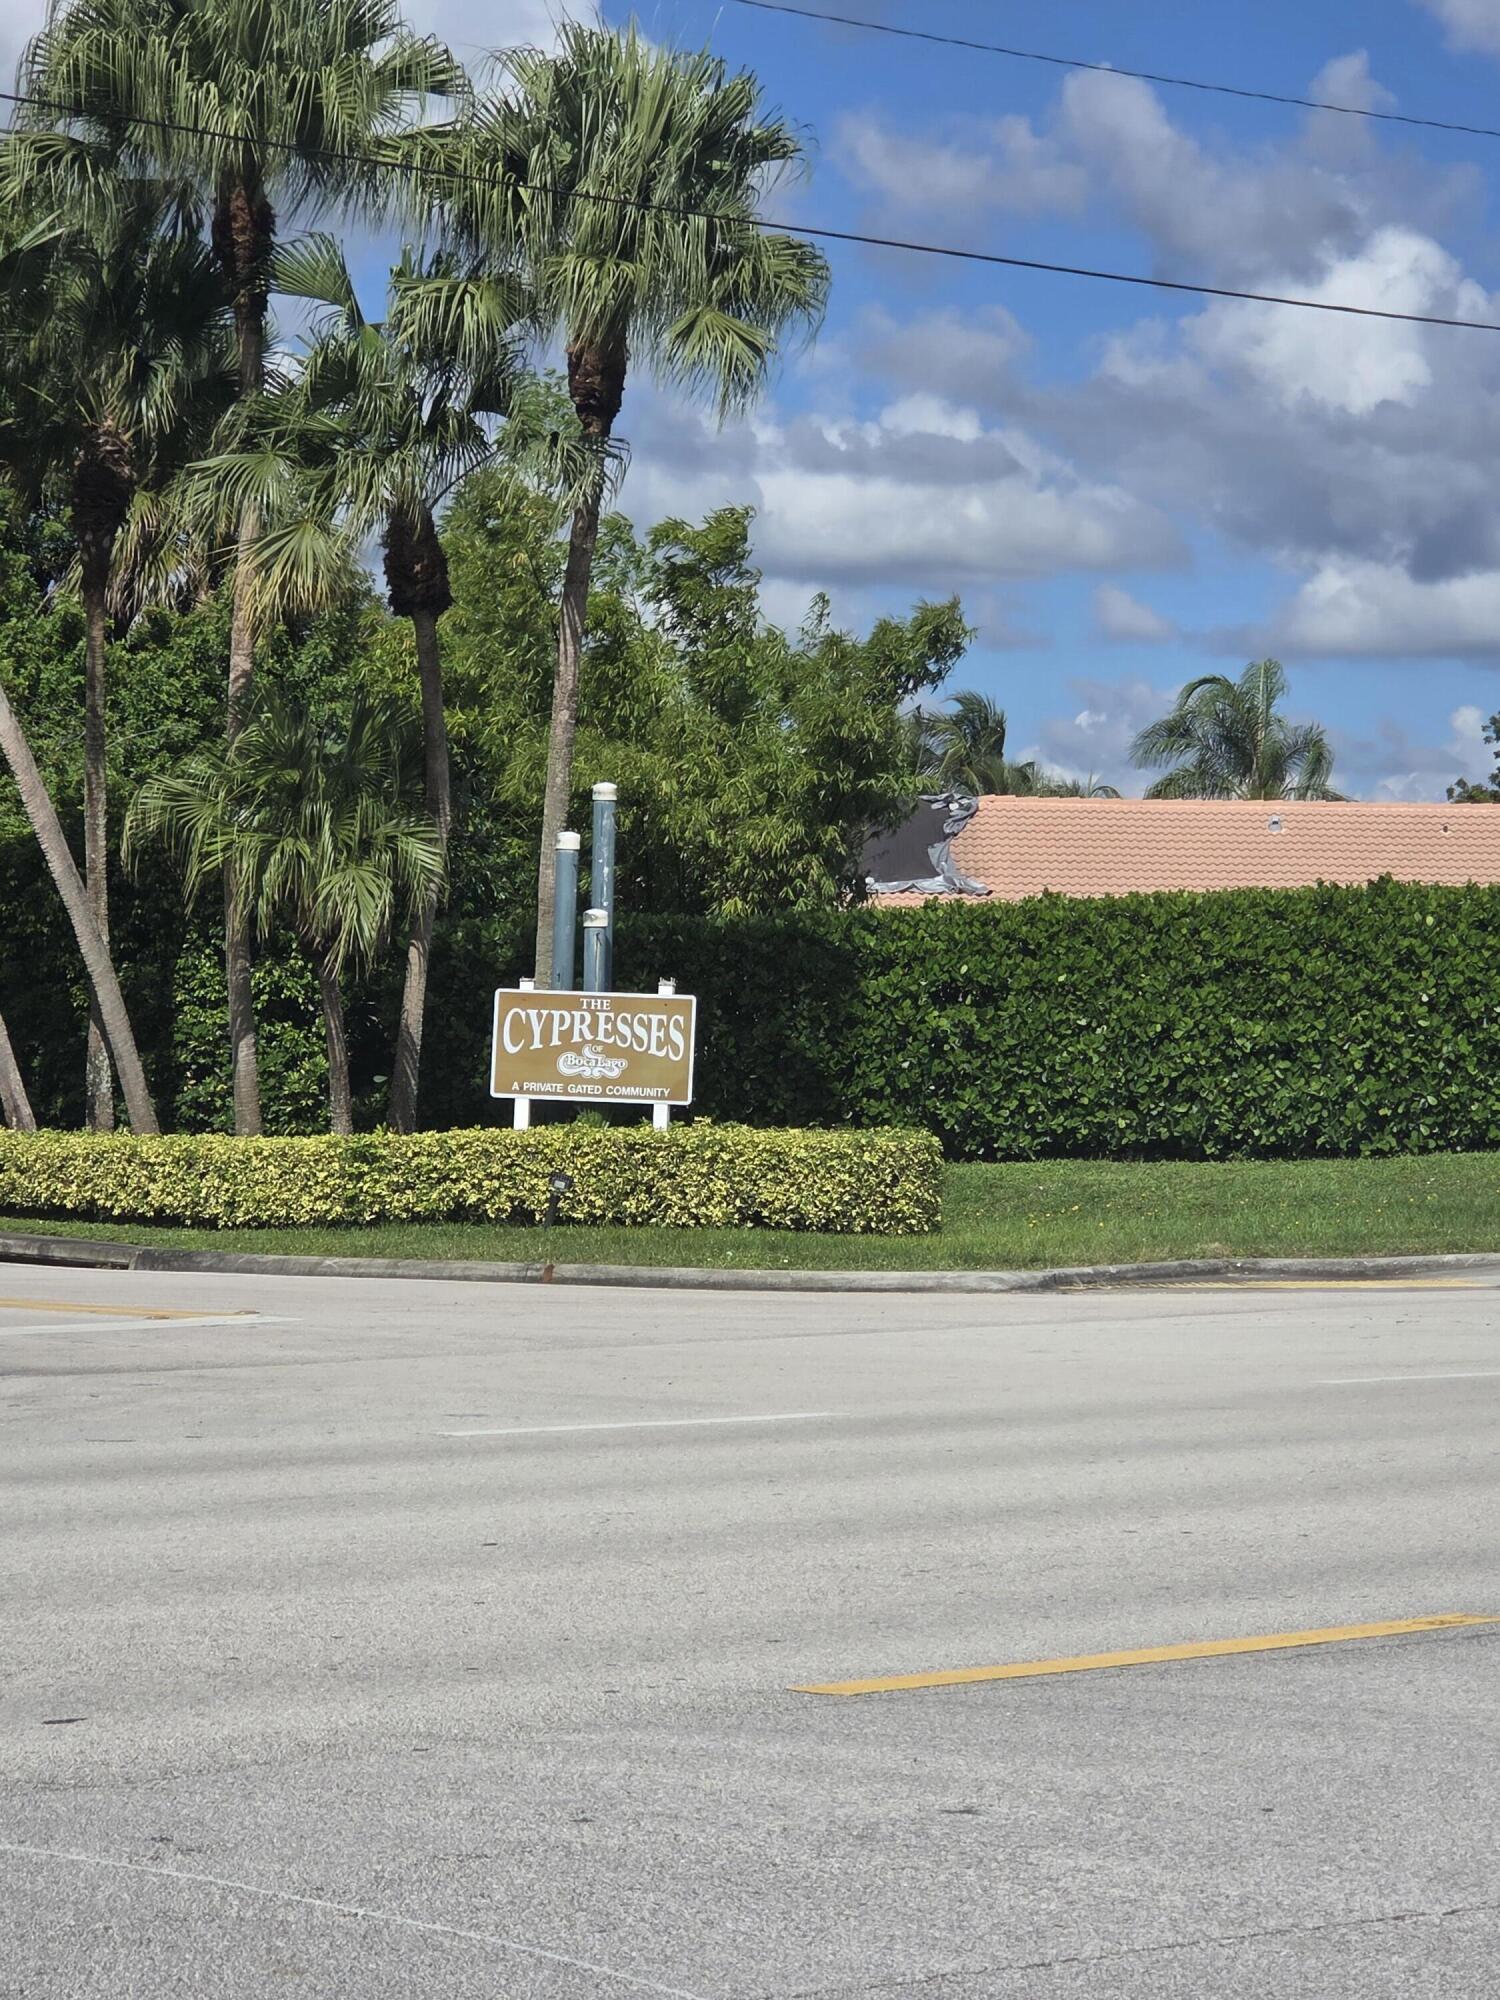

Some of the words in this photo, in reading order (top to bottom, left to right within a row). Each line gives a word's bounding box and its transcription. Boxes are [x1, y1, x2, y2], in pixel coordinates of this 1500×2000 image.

[580, 998, 611, 1010] THE
[503, 1007, 685, 1061] CYPRESSES
[592, 1045, 604, 1053] OF
[567, 1055, 595, 1067] Boca
[597, 1056, 626, 1070] Lago
[512, 1082, 520, 1091] A
[523, 1082, 563, 1093] PRIVATE
[568, 1084, 602, 1095] GATED
[606, 1085, 671, 1097] COMMUNITY
